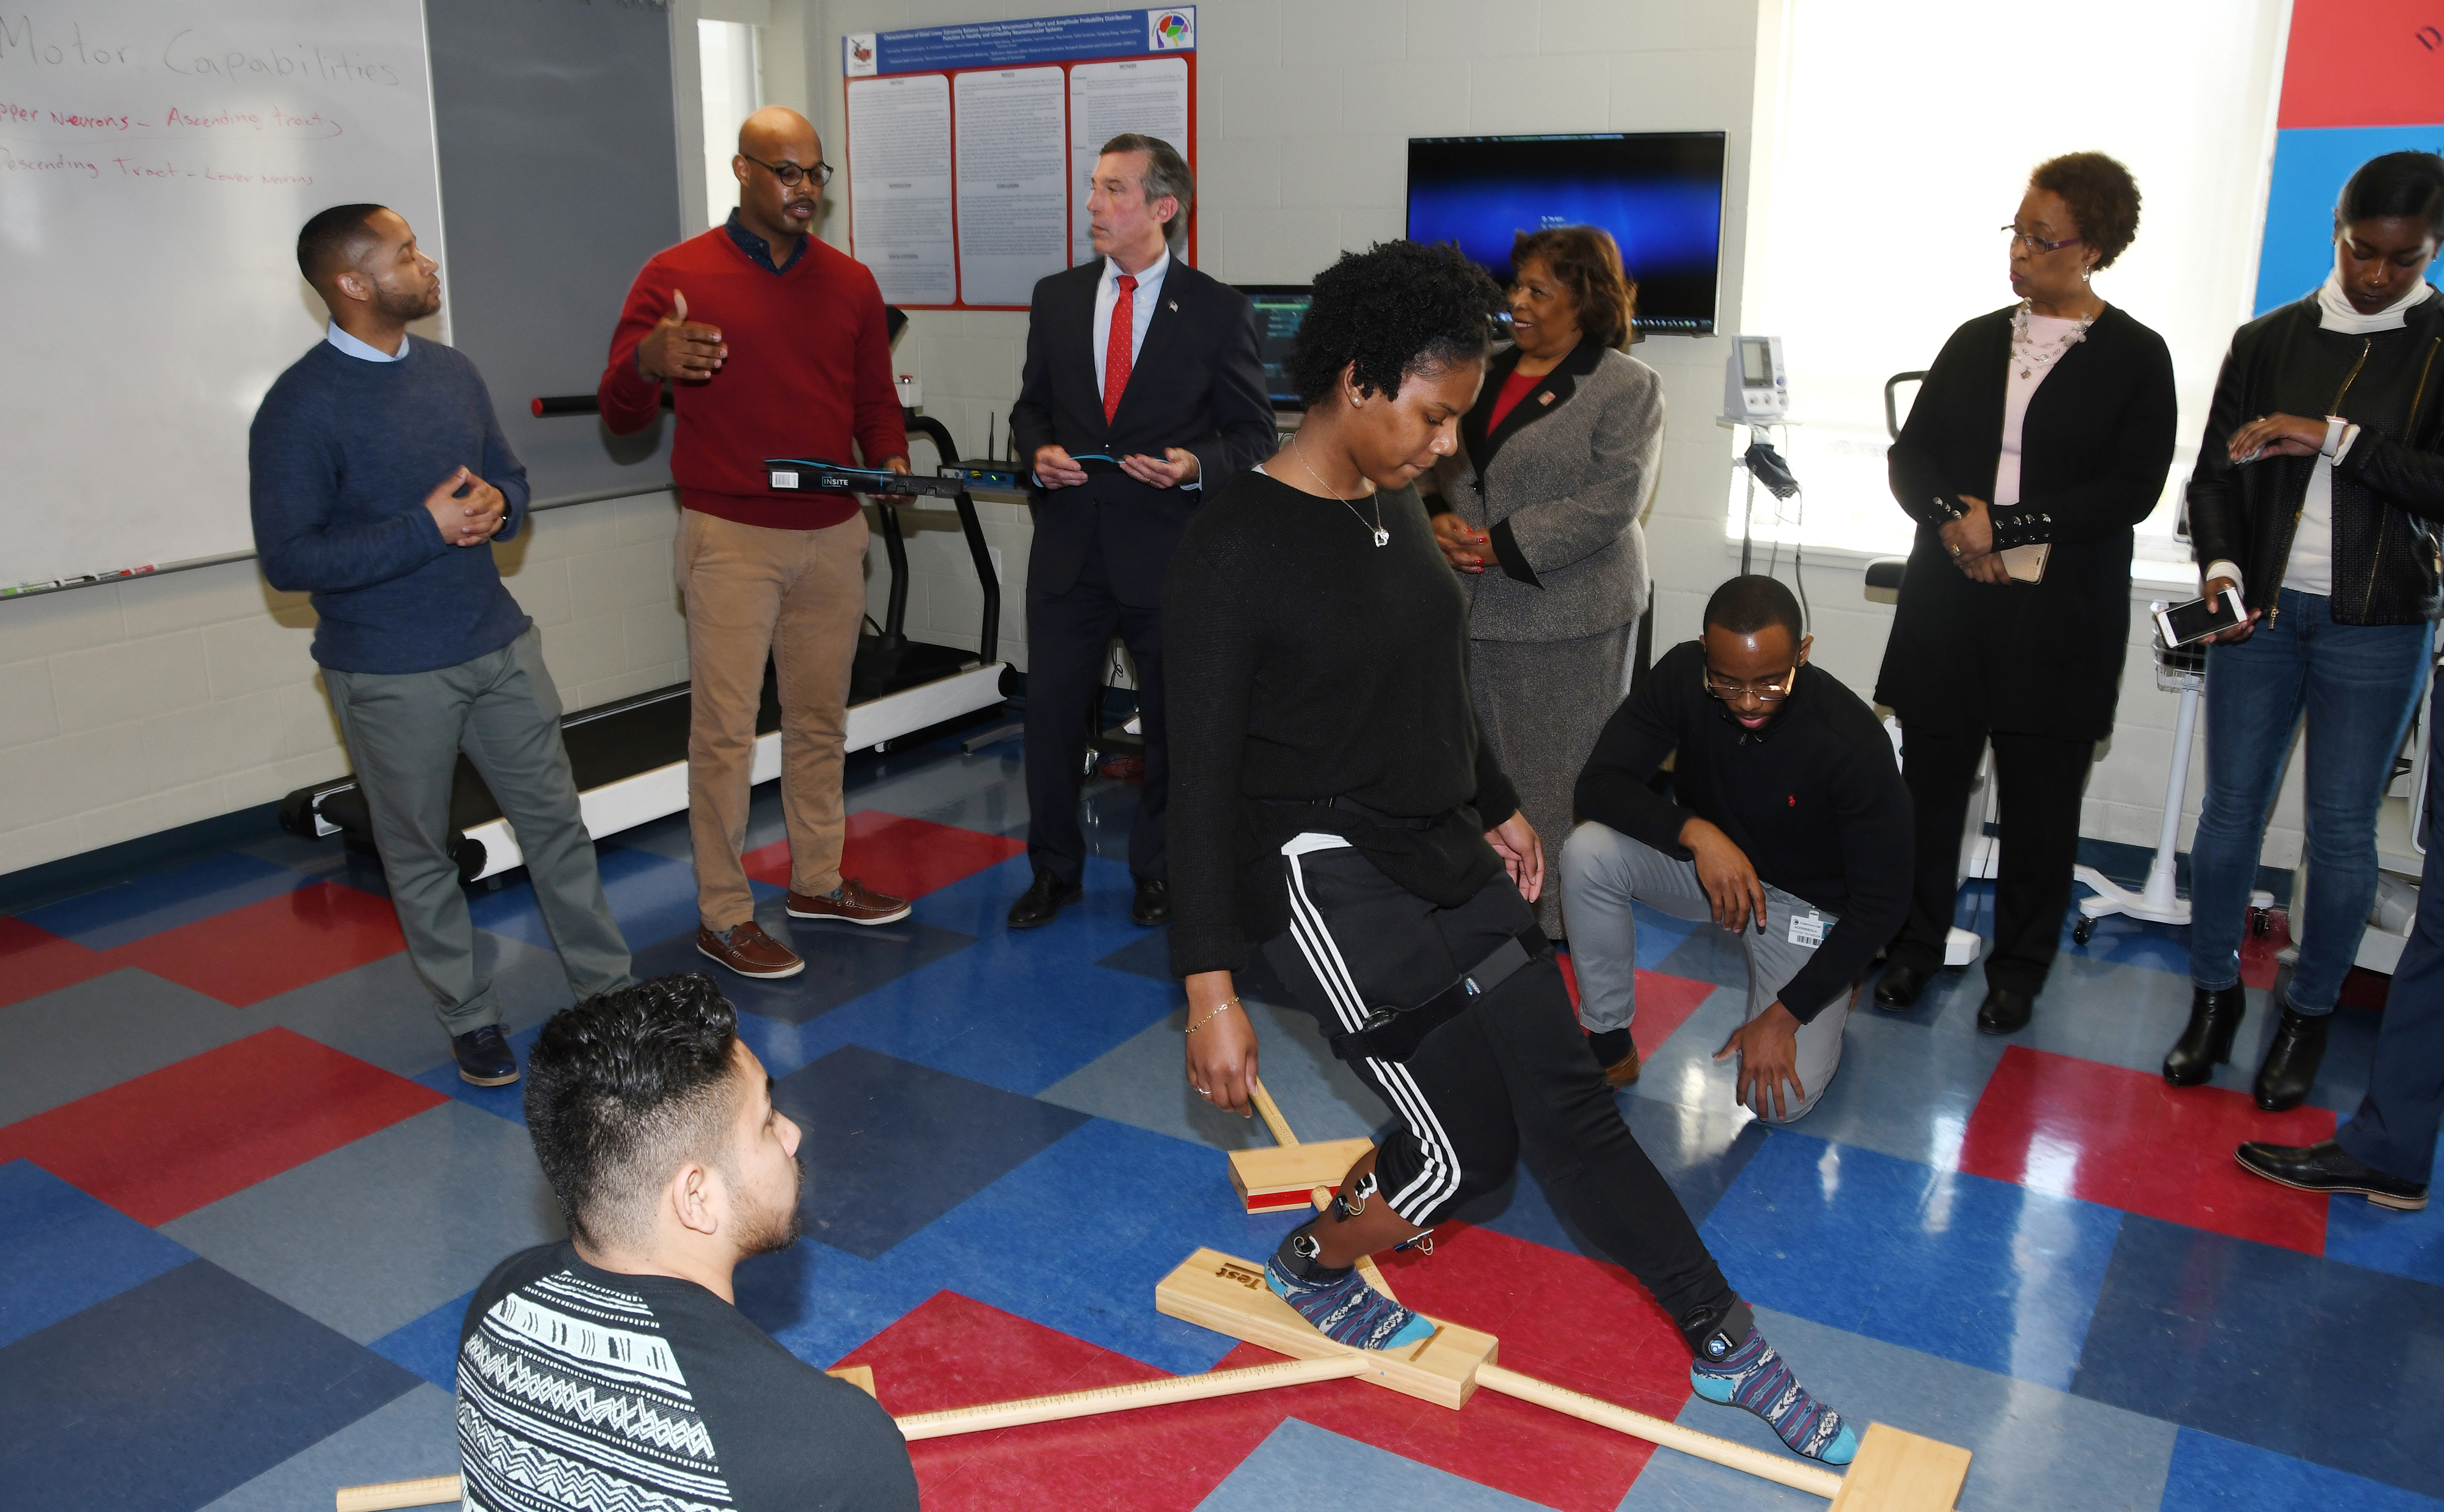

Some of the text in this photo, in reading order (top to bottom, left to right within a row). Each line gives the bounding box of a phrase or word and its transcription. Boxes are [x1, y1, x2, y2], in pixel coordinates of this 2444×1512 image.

[0, 15, 399, 86] Motor Capabilities
[51, 111, 128, 131] Neurons
[167, 107, 263, 130] Ascending
[112, 158, 178, 178] Tract
[1215, 1268, 1261, 1290] Test
